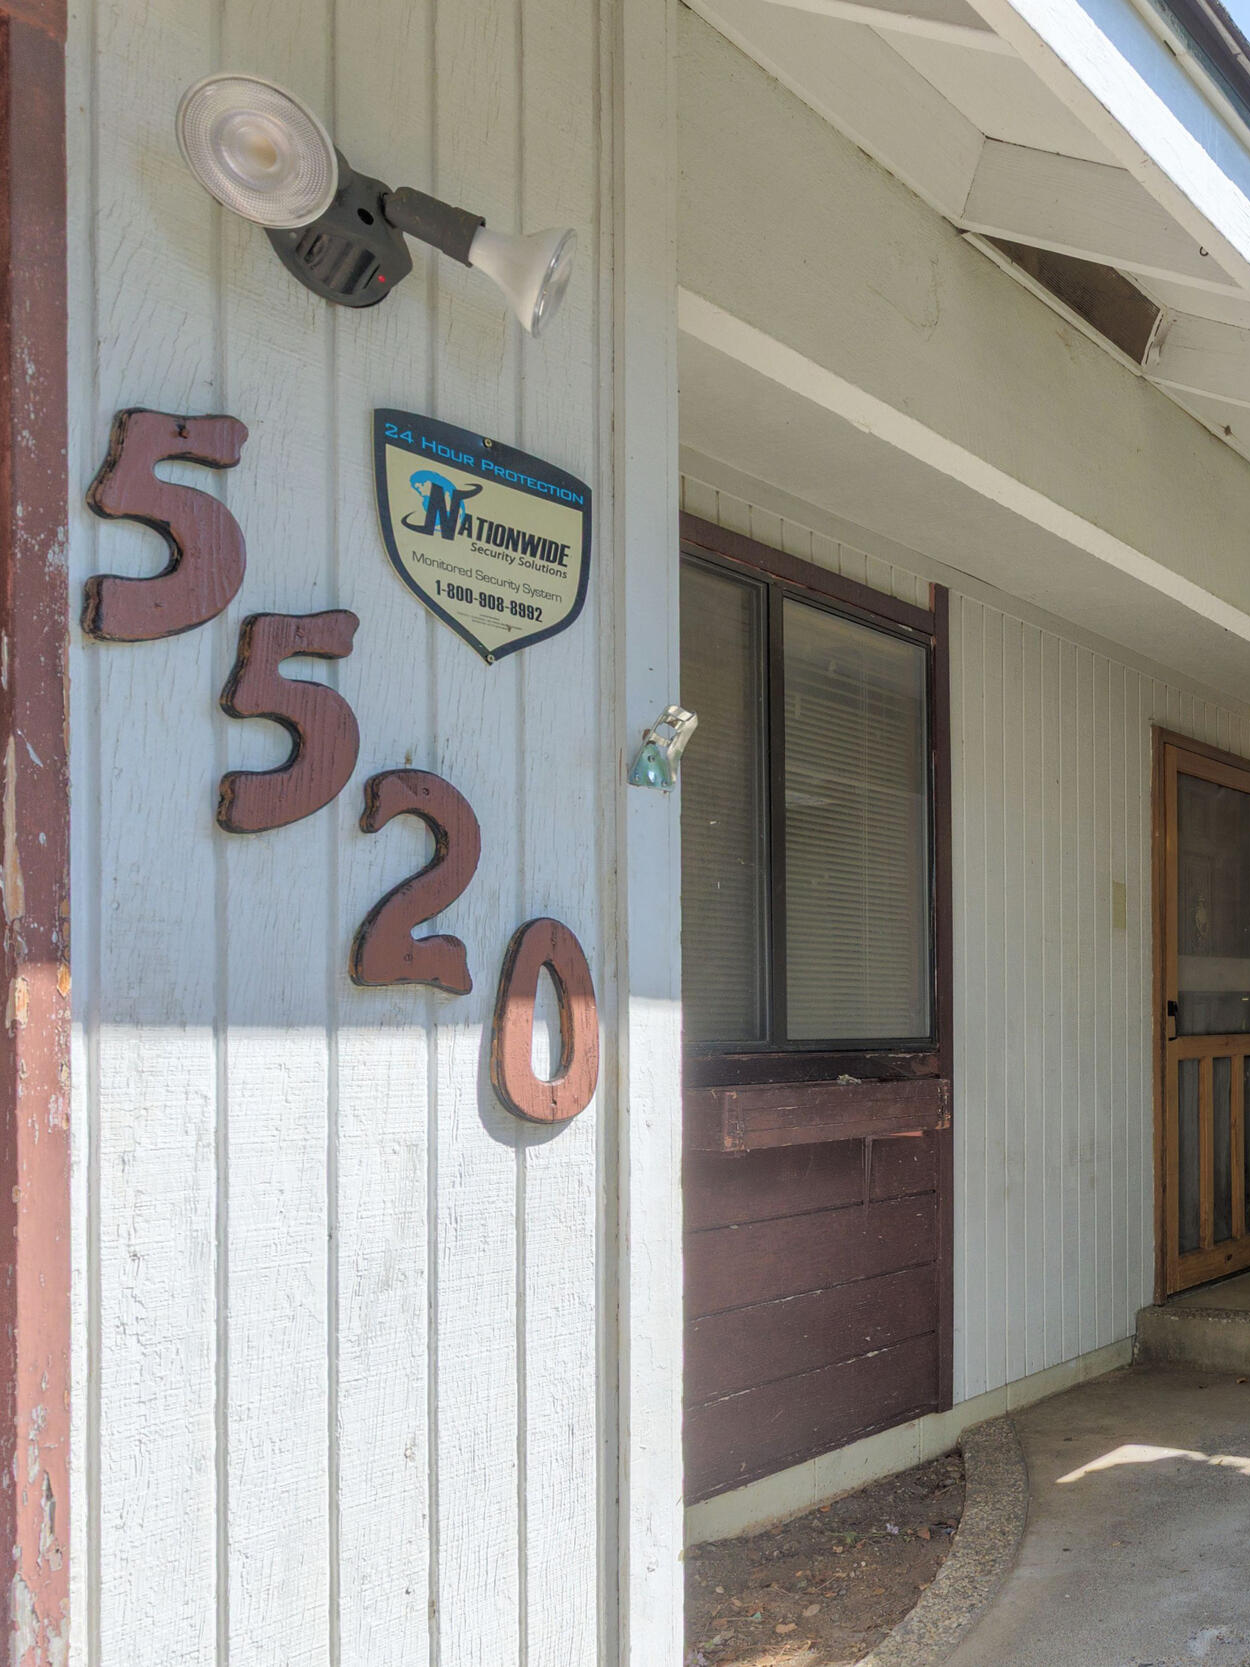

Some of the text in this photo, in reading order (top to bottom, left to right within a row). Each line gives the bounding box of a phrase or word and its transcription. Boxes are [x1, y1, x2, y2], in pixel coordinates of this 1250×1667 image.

[384, 422, 584, 505] 24 HOUR PROTECTION
[401, 481, 571, 568] NATIONWIDE
[411, 550, 563, 603] Monitored Security System
[470, 541, 568, 579] Security Solutions
[435, 580, 543, 623] 1-800-908-8992
[82, 407, 600, 1125] 5520
